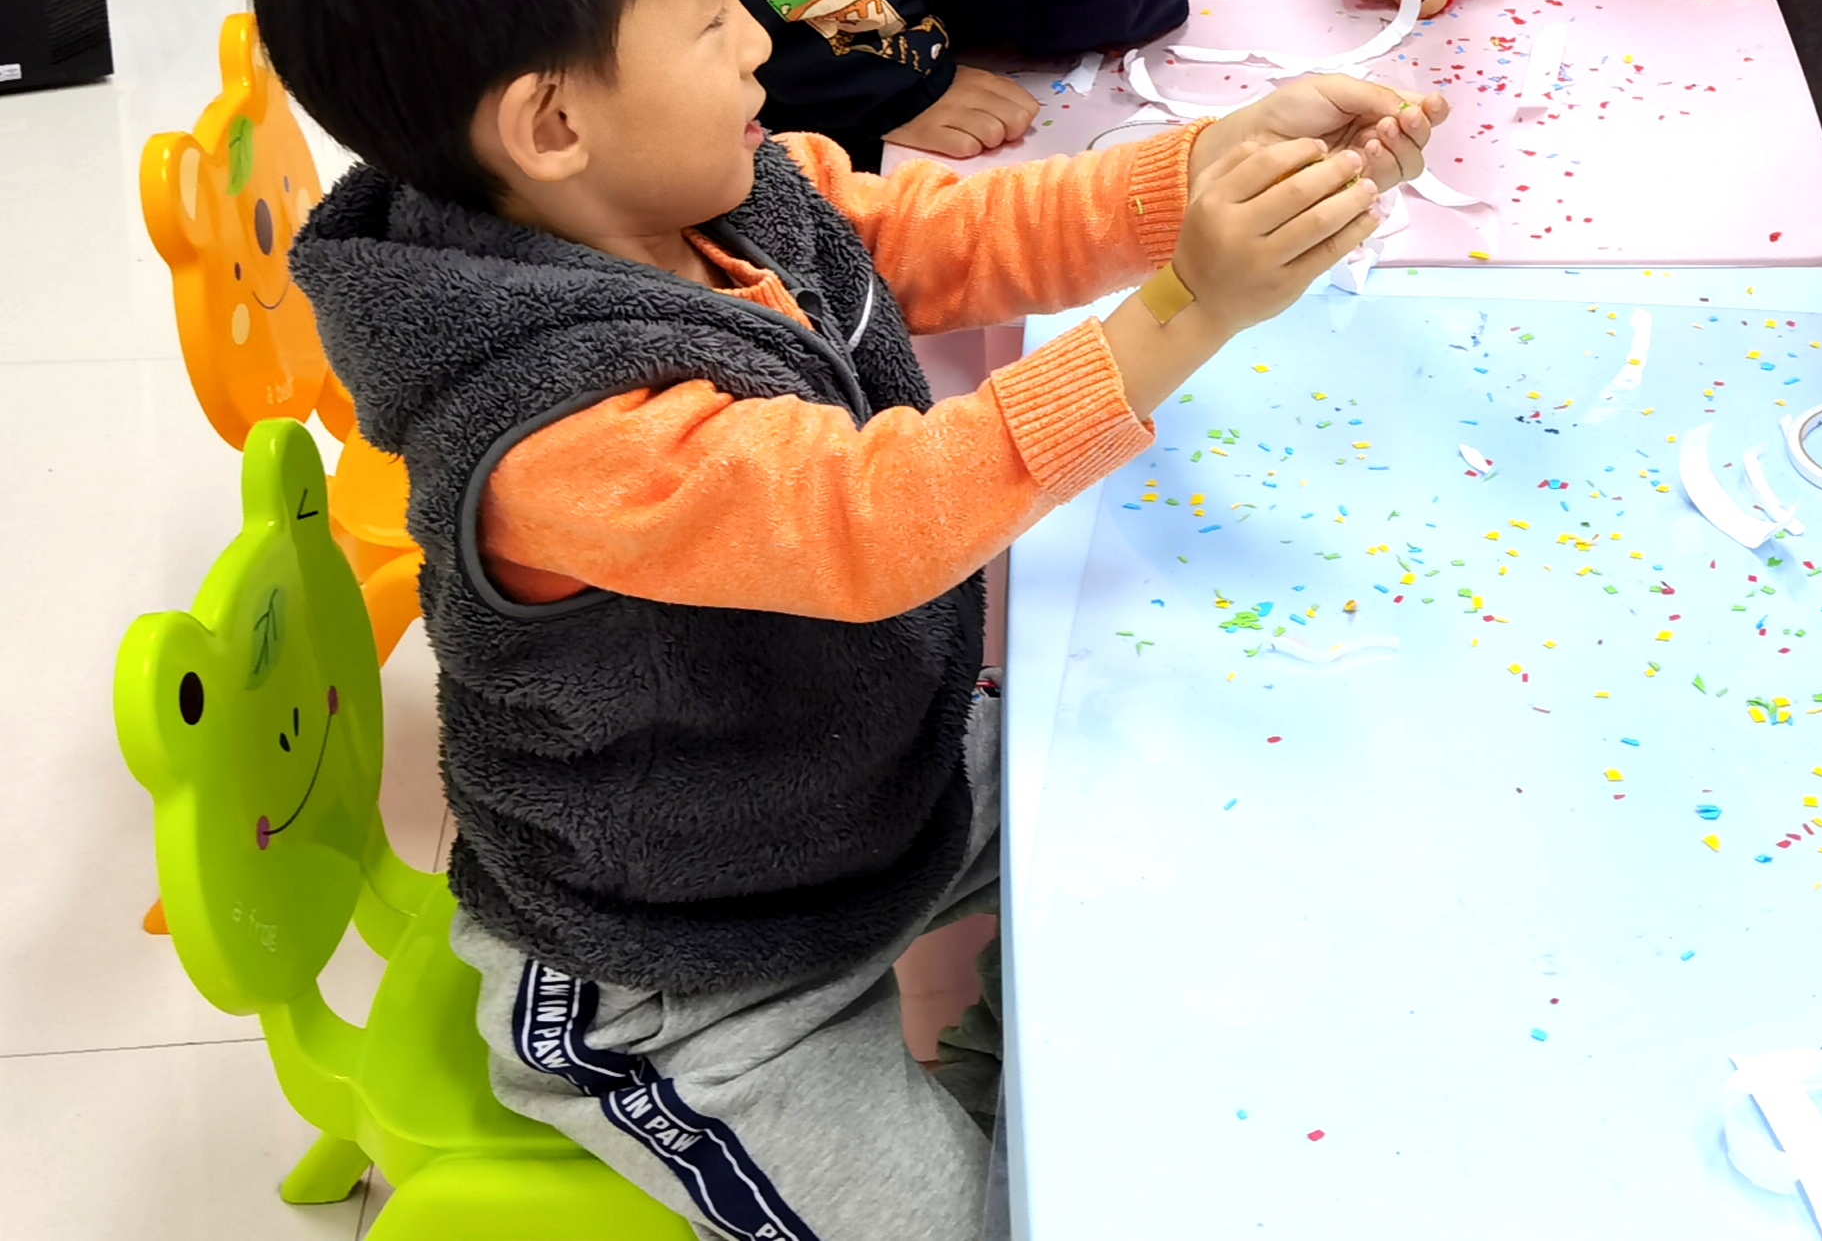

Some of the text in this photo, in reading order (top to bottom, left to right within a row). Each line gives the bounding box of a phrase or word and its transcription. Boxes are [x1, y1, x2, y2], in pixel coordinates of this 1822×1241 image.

[531, 966, 571, 1069] AW IN PAW
[621, 1087, 704, 1153] IN PAW
